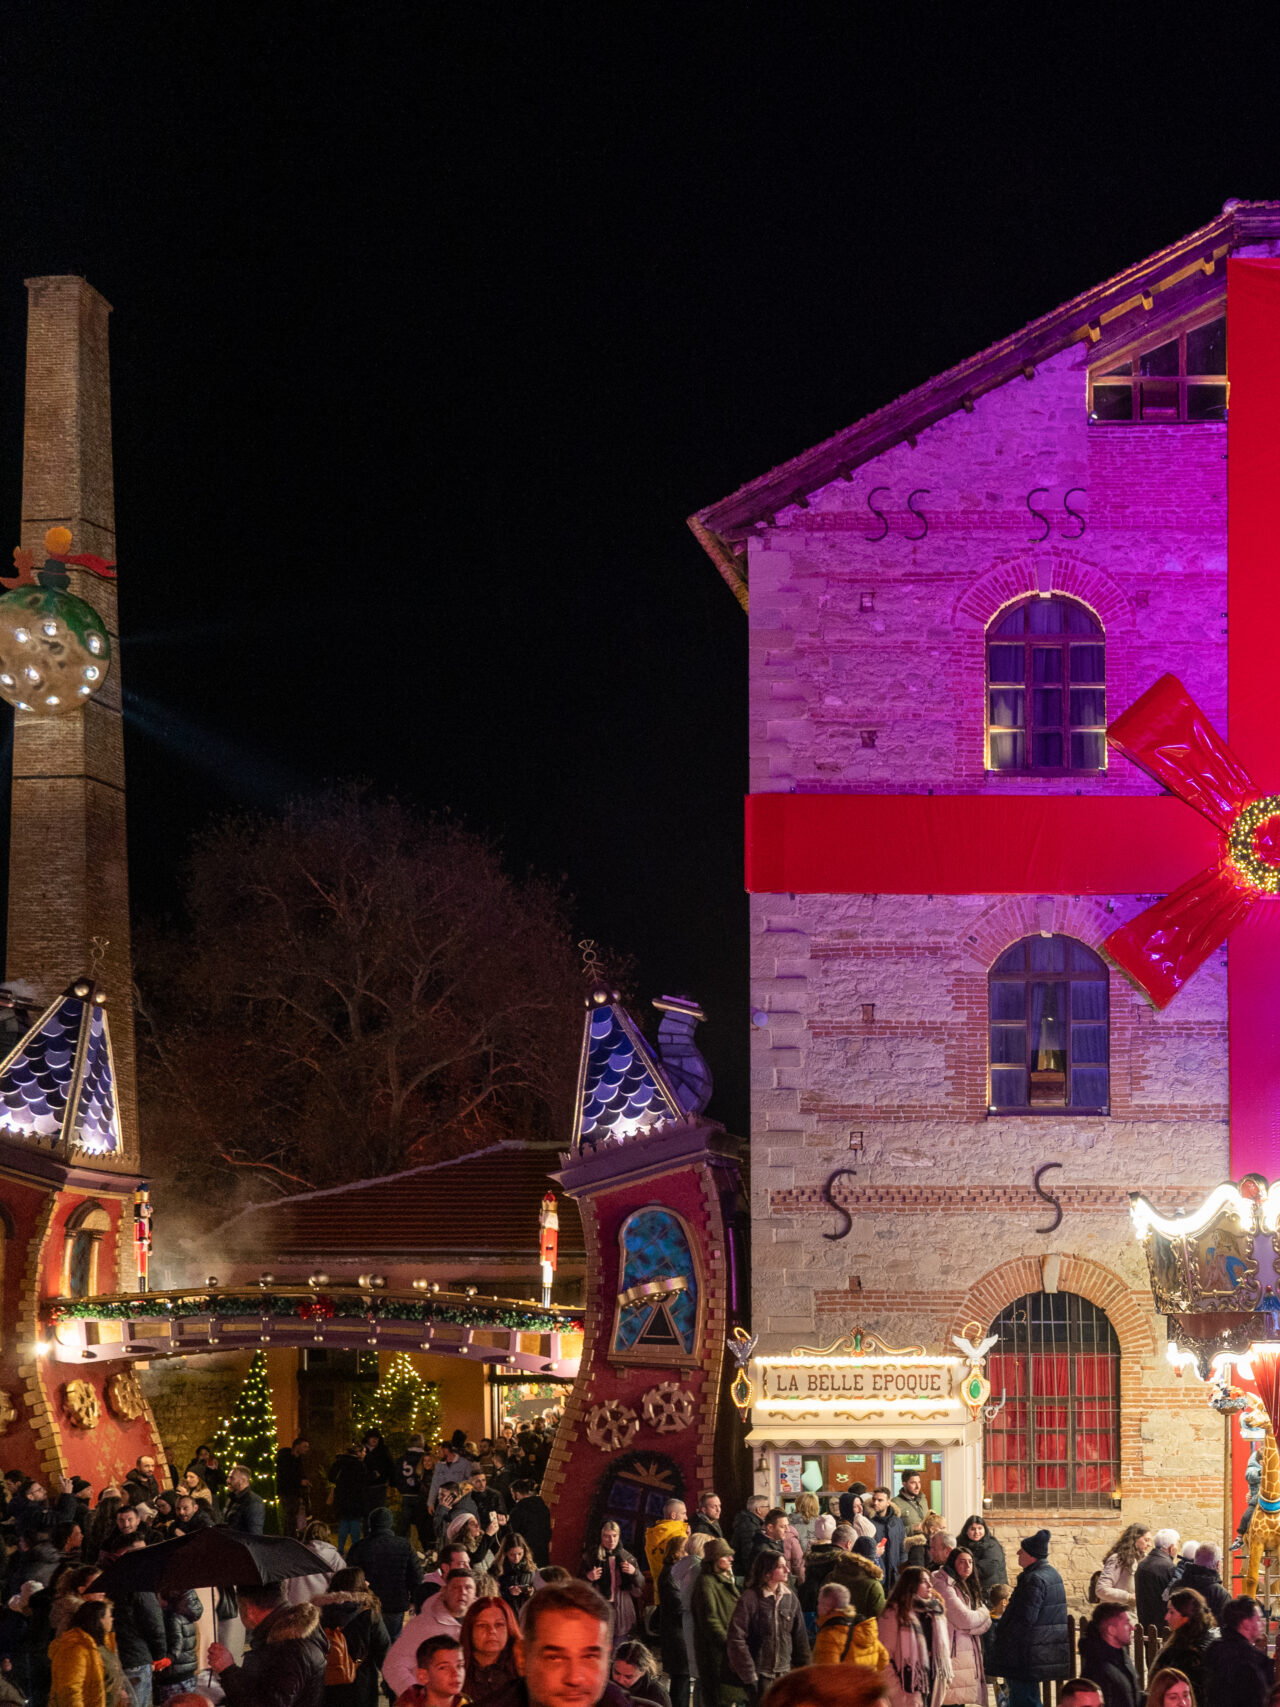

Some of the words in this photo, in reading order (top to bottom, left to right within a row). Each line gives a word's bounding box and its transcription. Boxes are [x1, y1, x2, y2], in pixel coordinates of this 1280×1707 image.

[777, 1374, 799, 1392] LA
[807, 1374, 864, 1392] BELLE
[872, 1374, 941, 1394] EPOQUE
